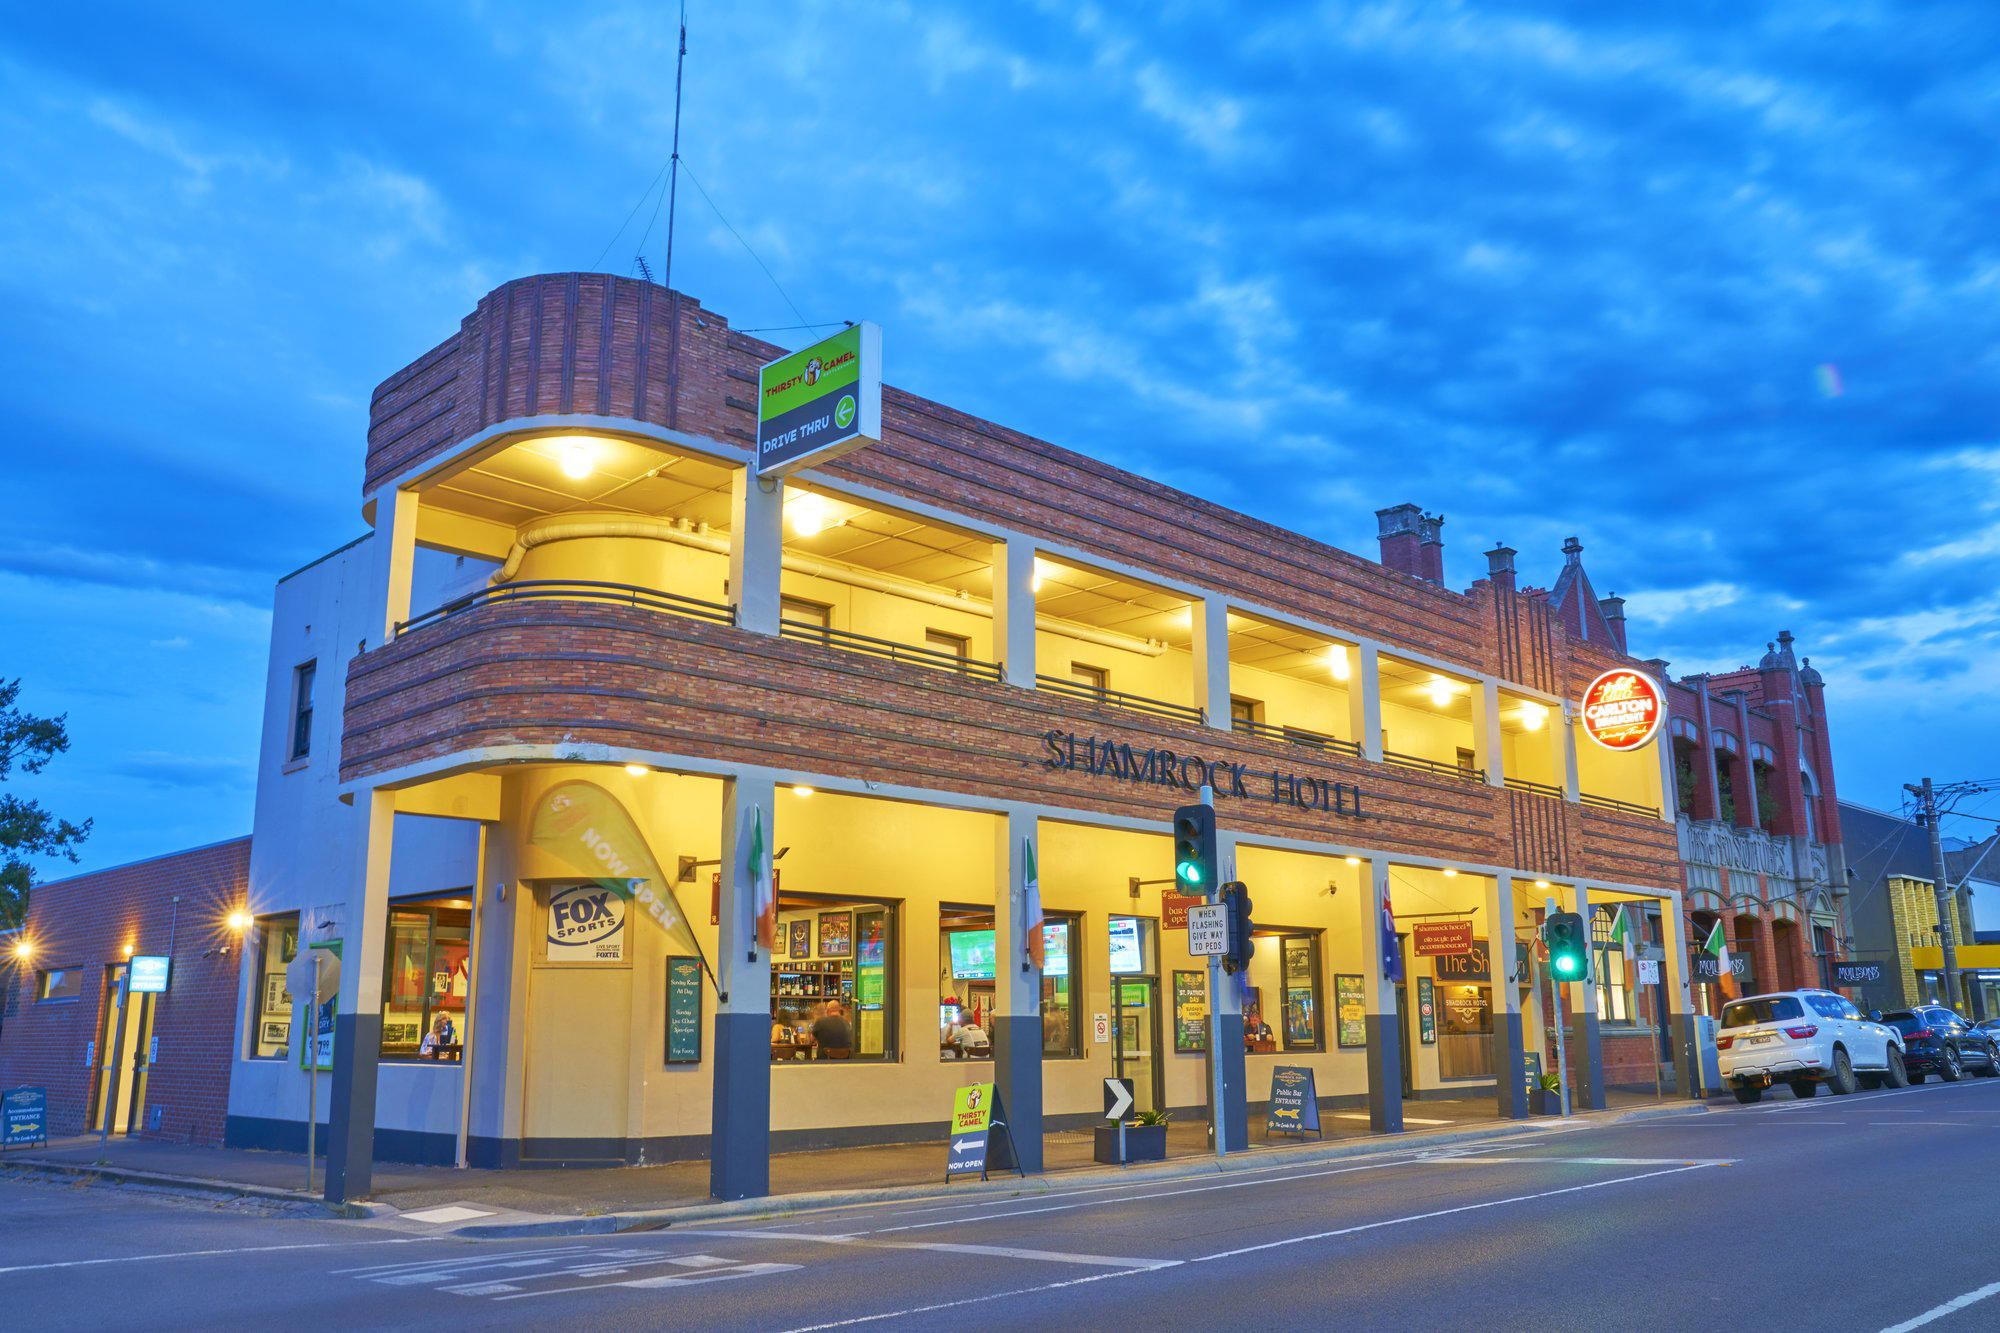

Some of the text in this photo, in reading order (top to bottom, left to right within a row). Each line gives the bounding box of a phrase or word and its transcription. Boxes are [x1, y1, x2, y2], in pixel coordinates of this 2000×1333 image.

[766, 351, 855, 397] THIRSTY CAMEL
[762, 415, 830, 454] DRIVE THRU
[1040, 729, 1365, 818] SHAMROCK HOTEL
[581, 828, 629, 875] NOW
[626, 878, 677, 929] OPEN
[552, 892, 614, 929] FOX
[1198, 909, 1217, 919] WHEN
[557, 917, 616, 938] SPORTS
[1192, 919, 1224, 930] FLASHING
[1192, 930, 1223, 941] GIVE WAY
[1450, 934, 1462, 943] pub
[1195, 941, 1222, 951] TO PEDS
[684, 987, 693, 996] Day
[1473, 999, 1488, 1007] HOTEL
[675, 1009, 692, 1017] Sunday
[1276, 1088, 1302, 1097] Public Bar
[1275, 1097, 1302, 1106] ENTRANCE
[10, 1113, 41, 1121] ENTRANCE
[957, 1110, 987, 1120] THIRSTY
[959, 1118, 983, 1128] CAMEL
[948, 1159, 983, 1170] NOW OPEN
